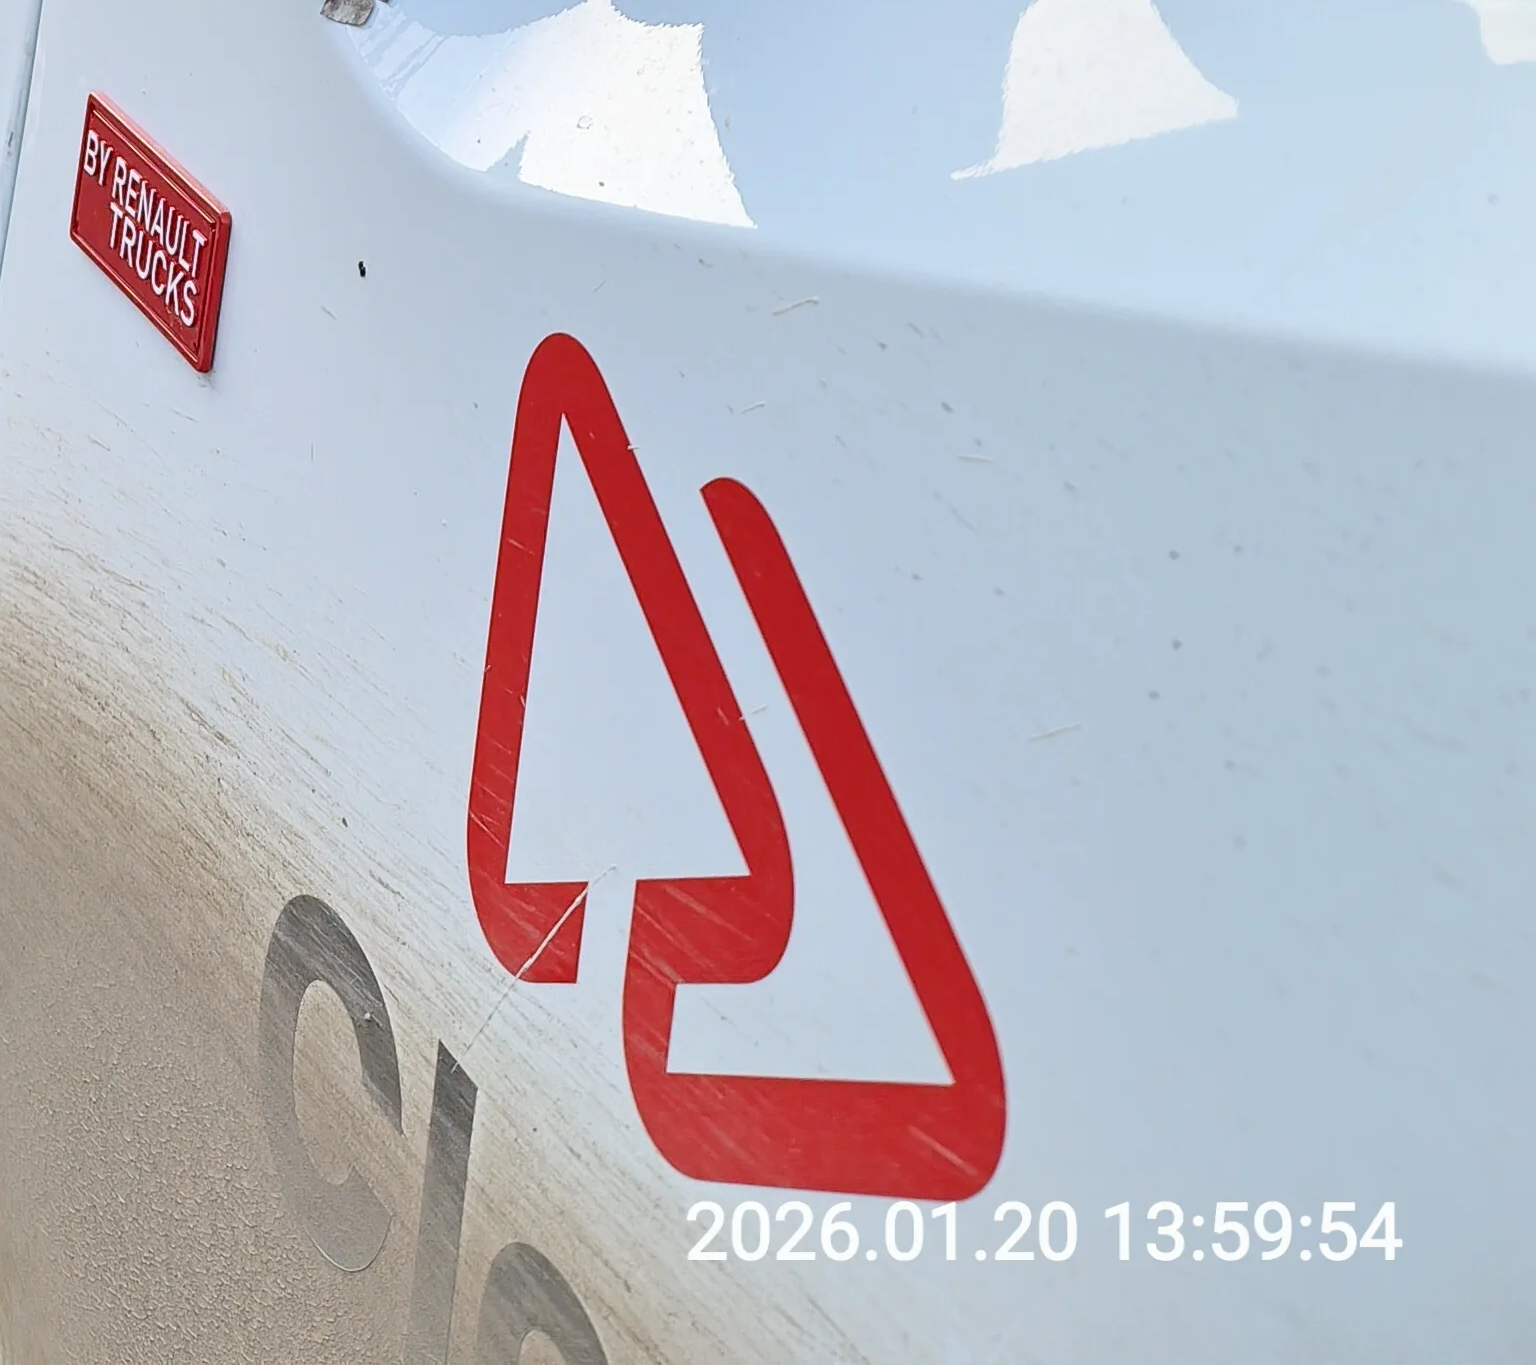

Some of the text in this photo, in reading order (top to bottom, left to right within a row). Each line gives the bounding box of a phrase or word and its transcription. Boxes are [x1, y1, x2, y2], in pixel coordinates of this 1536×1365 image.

[83, 129, 206, 277] BY RENAULT
[109, 201, 198, 327] TRUCKS
